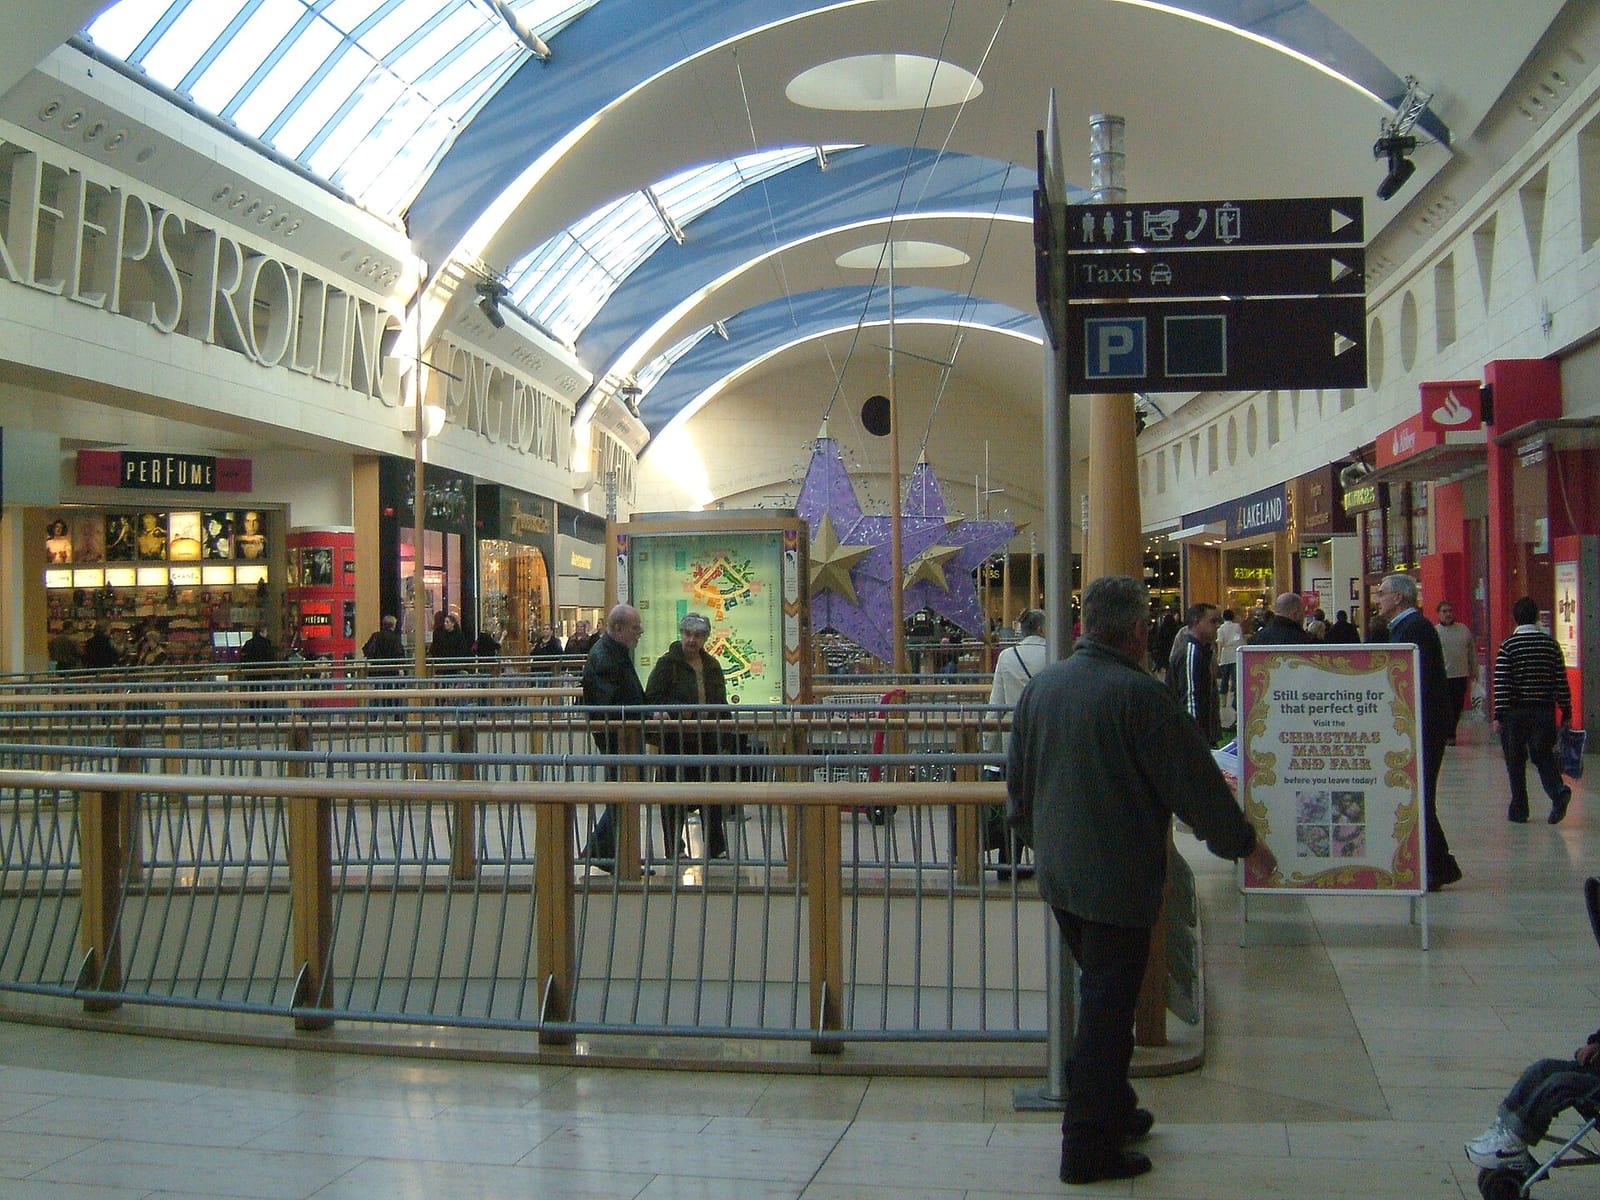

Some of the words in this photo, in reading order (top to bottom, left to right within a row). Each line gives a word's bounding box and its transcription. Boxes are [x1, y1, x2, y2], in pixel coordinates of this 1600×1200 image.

[1083, 264, 1142, 283] Taxis
[1098, 326, 1134, 373] P
[127, 457, 212, 486] PERFUME
[1242, 497, 1282, 529] LAKELAND
[1273, 690, 1298, 701] Still
[1302, 690, 1363, 702] searching
[1366, 690, 1385, 701] for
[1281, 703, 1305, 714] that
[1308, 703, 1354, 716] perfect
[1357, 703, 1378, 716] gift
[1313, 719, 1330, 727] Visit
[1332, 719, 1345, 727] the
[1279, 732, 1381, 744] CHRISTMAS
[1292, 744, 1367, 757] MARKET
[1288, 757, 1325, 770] AND
[1329, 757, 1372, 770] FAIR
[1284, 776, 1311, 784] before
[1312, 777, 1327, 786] you
[1328, 776, 1350, 784] leave
[1351, 776, 1377, 786] today!
